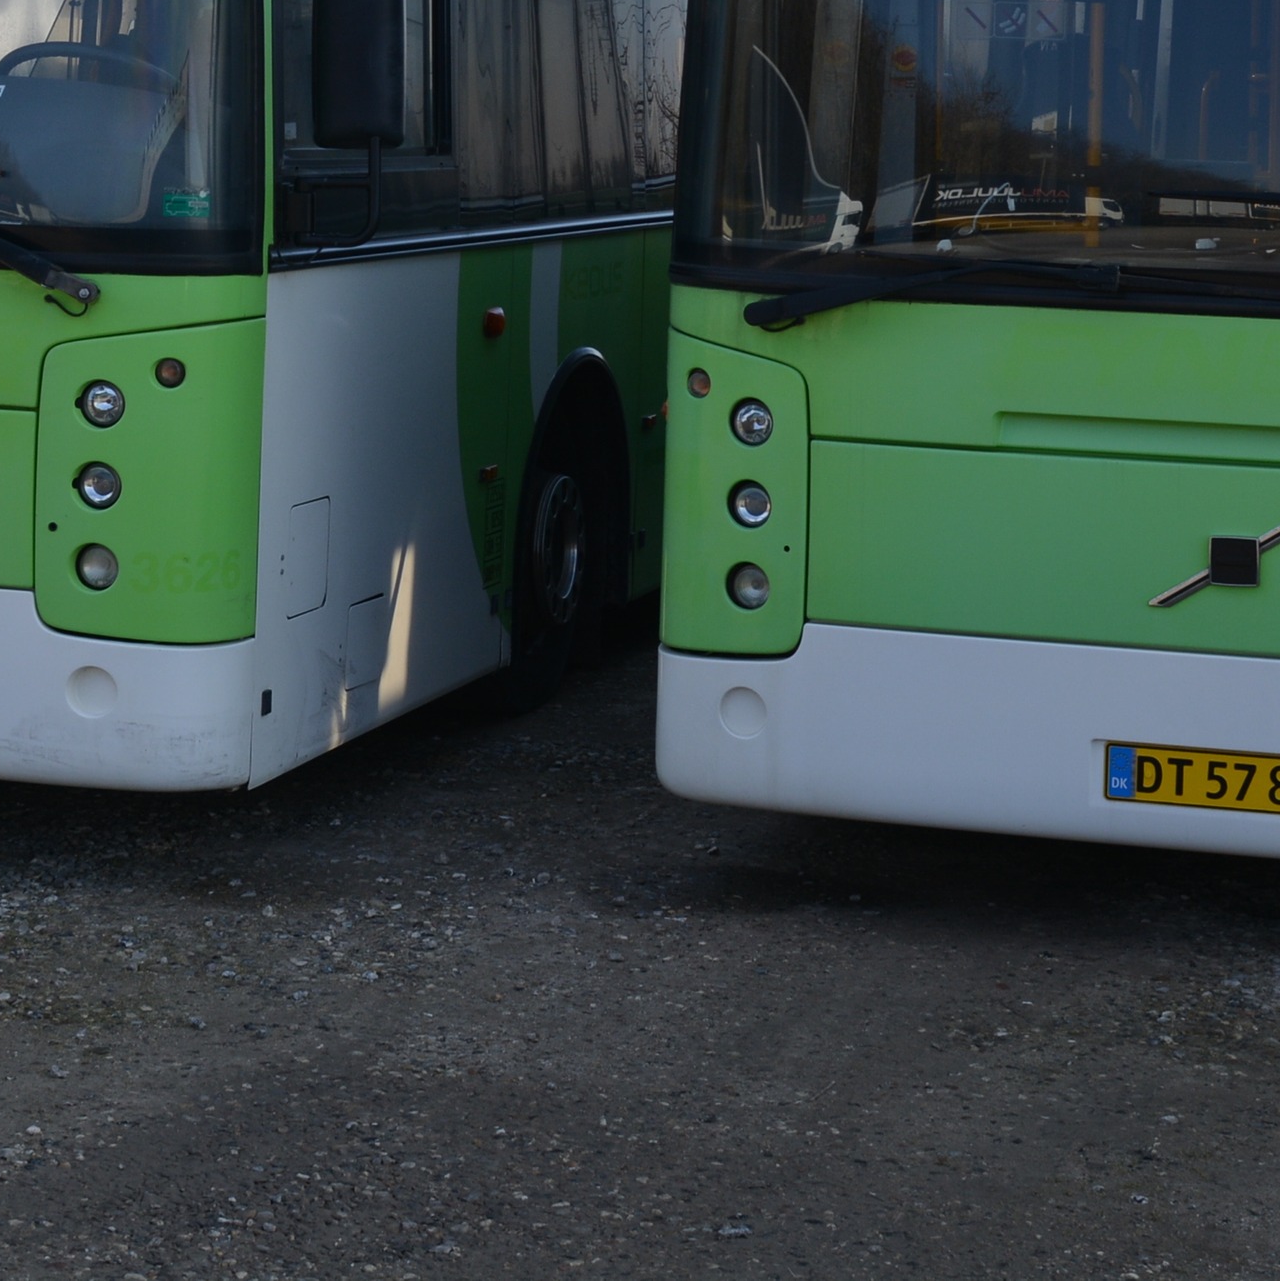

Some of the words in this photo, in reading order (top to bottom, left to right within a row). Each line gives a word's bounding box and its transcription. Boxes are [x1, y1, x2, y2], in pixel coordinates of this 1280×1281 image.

[127, 550, 243, 595] 3626
[1110, 776, 1129, 790] DK
[1136, 755, 1194, 797] DT
[1205, 760, 1257, 801] 57
